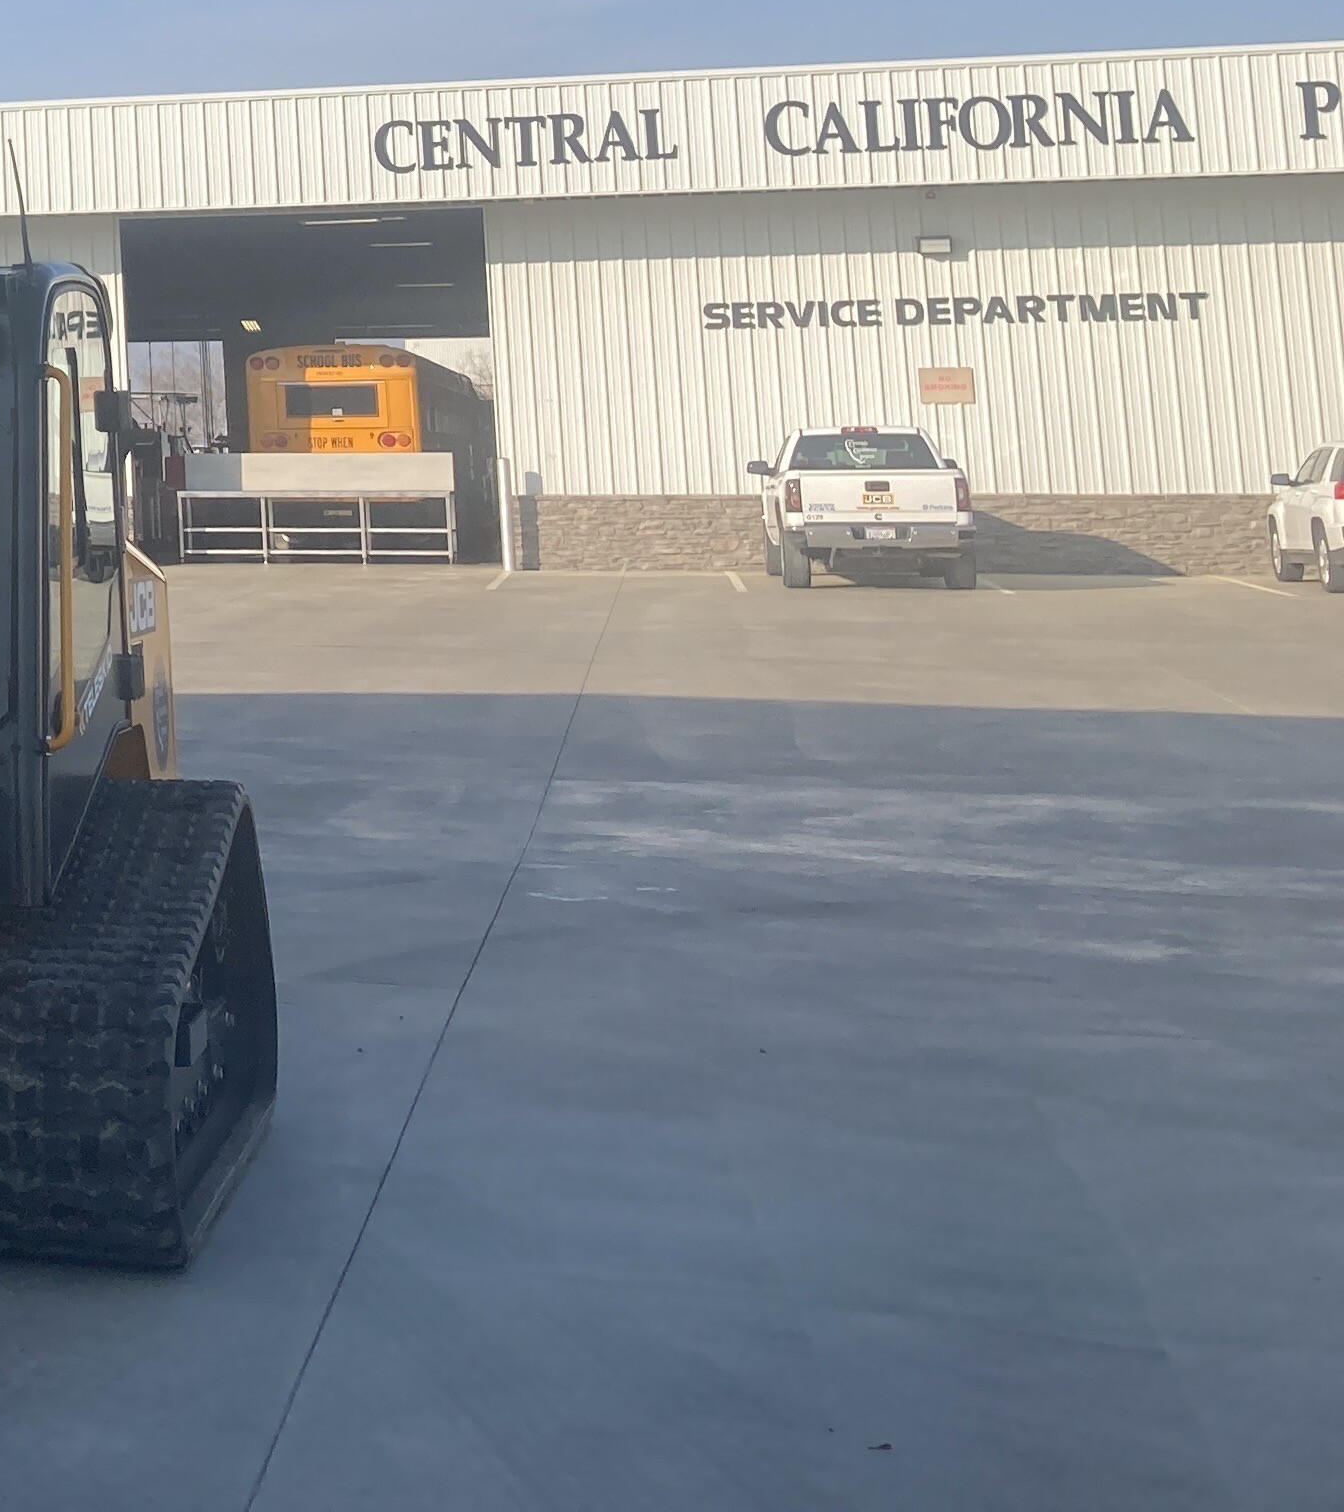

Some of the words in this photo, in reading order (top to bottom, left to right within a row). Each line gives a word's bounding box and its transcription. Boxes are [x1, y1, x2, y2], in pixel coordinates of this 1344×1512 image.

[374, 108, 678, 174] CENTRAL
[764, 88, 1195, 156] CALIFORNIA
[1295, 81, 1342, 140] P
[703, 299, 883, 330] SERVICE
[894, 291, 1210, 326] DEPARTMENT
[297, 354, 338, 368] SCHOOL
[341, 353, 362, 367] BUS
[308, 437, 328, 449] STOP
[331, 437, 354, 449] WHEN
[864, 495, 892, 503] JCB
[130, 579, 155, 633] JCB
